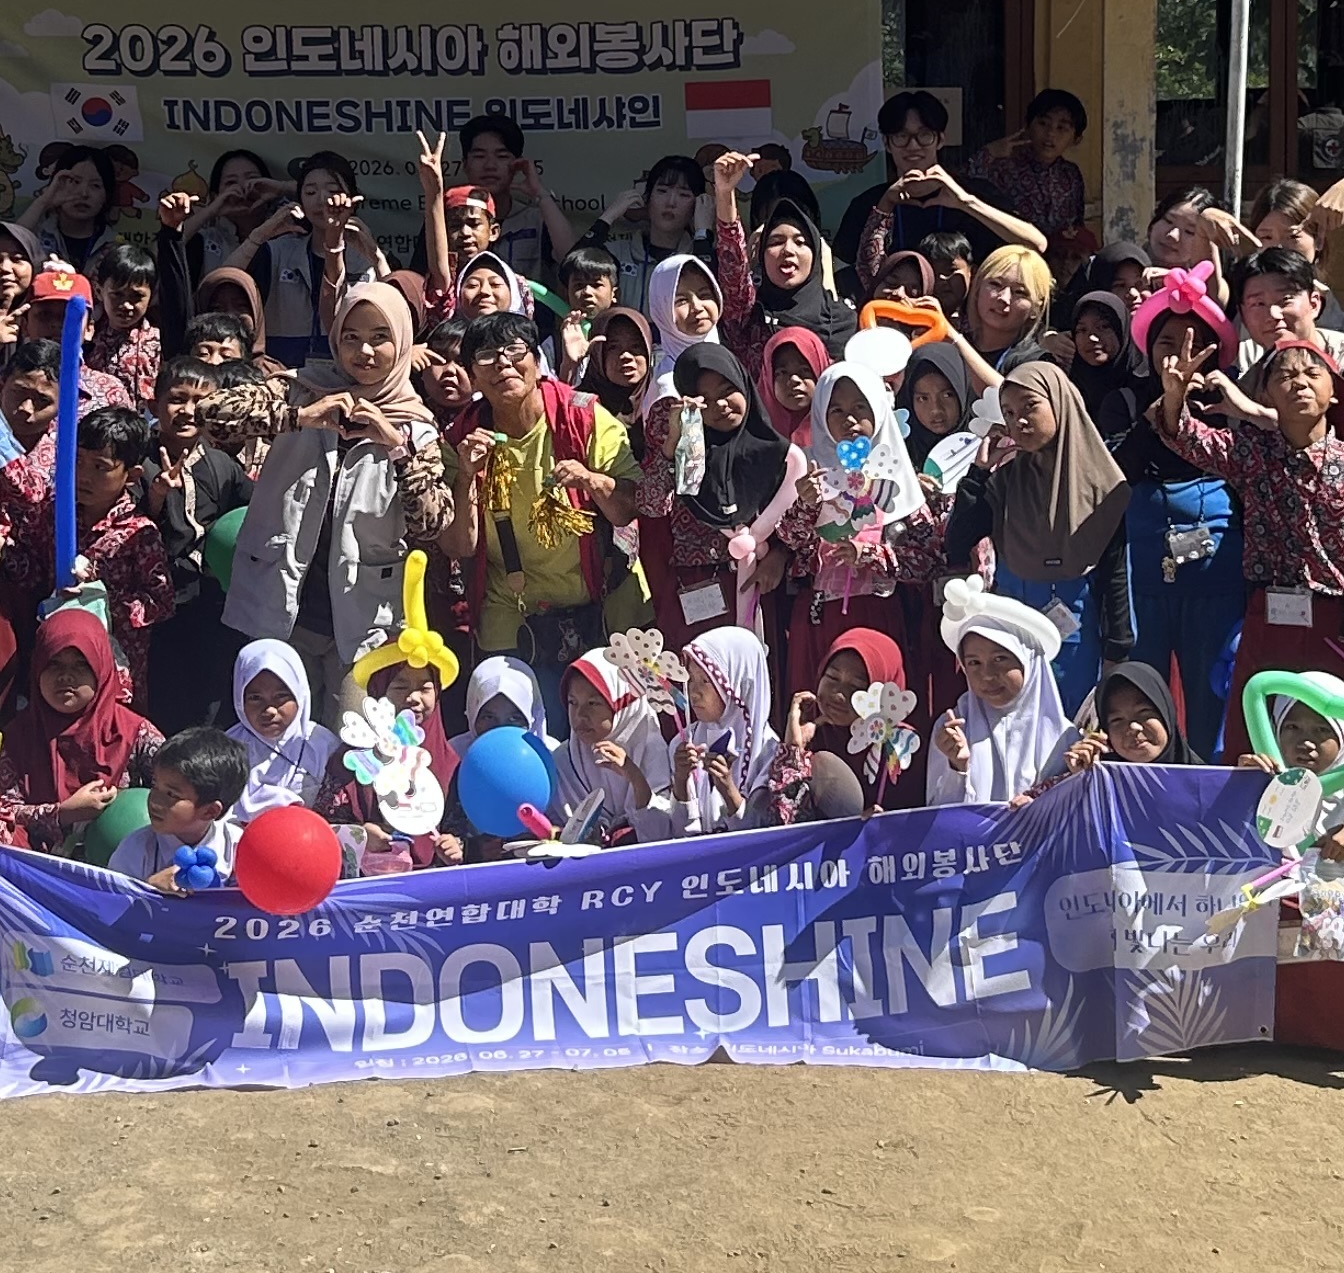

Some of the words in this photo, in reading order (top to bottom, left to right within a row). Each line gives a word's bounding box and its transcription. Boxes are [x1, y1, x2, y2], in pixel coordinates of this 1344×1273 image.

[82, 24, 232, 77] 2026
[241, 22, 488, 76] 인도네시아
[496, 17, 742, 75] 해외봉사단
[162, 98, 471, 133] INDONESHINE
[360, 195, 412, 211] reme
[214, 915, 332, 941] 2026
[353, 895, 562, 934] 순천연합대학
[581, 881, 663, 911] RCY
[682, 858, 850, 900] 인도네시아
[868, 840, 1024, 886] 해외봉사단
[227, 891, 1031, 1053] INDONESHINE
[59, 1008, 151, 1037] 청암대학교
